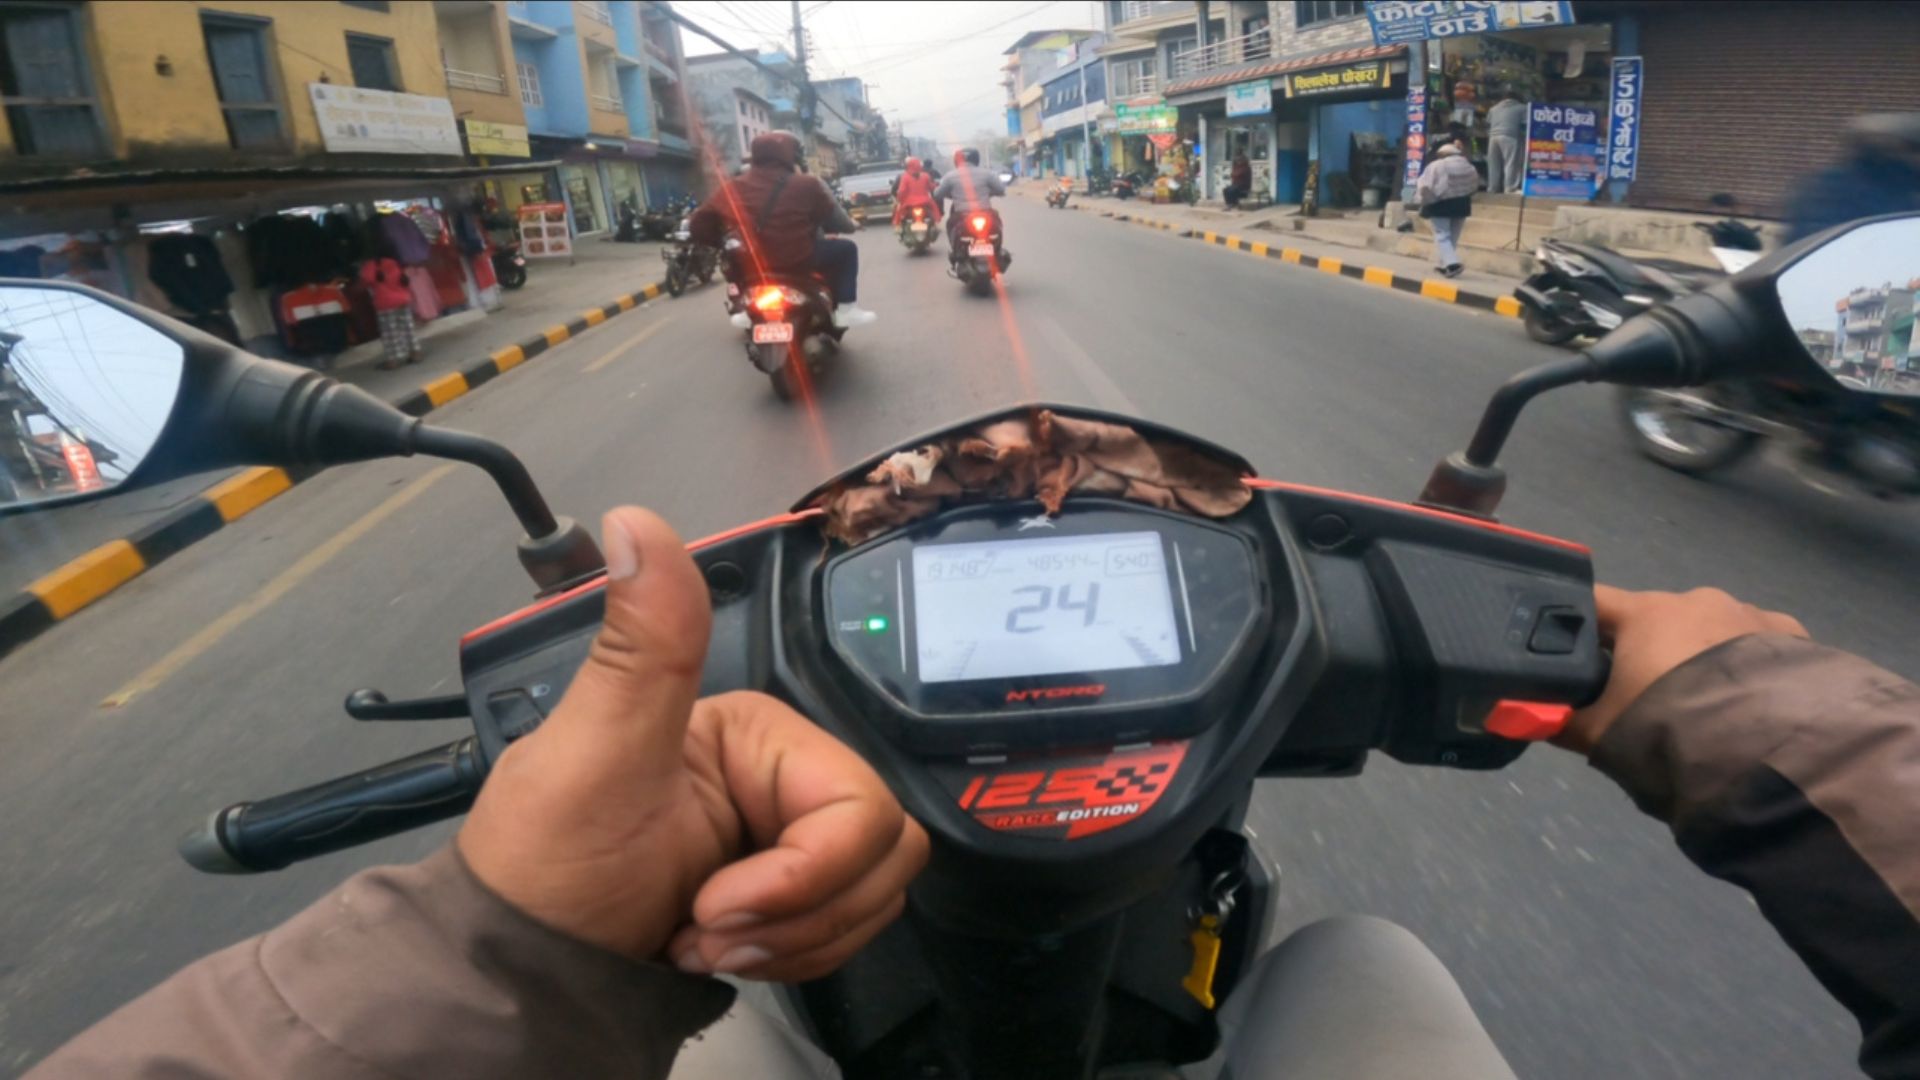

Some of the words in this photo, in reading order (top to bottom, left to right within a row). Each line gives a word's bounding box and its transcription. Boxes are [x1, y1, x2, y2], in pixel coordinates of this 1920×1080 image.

[1005, 582, 1100, 633] 24
[959, 765, 1104, 810] 125
[995, 812, 1055, 828] RACE
[1056, 803, 1139, 822] EDITION
